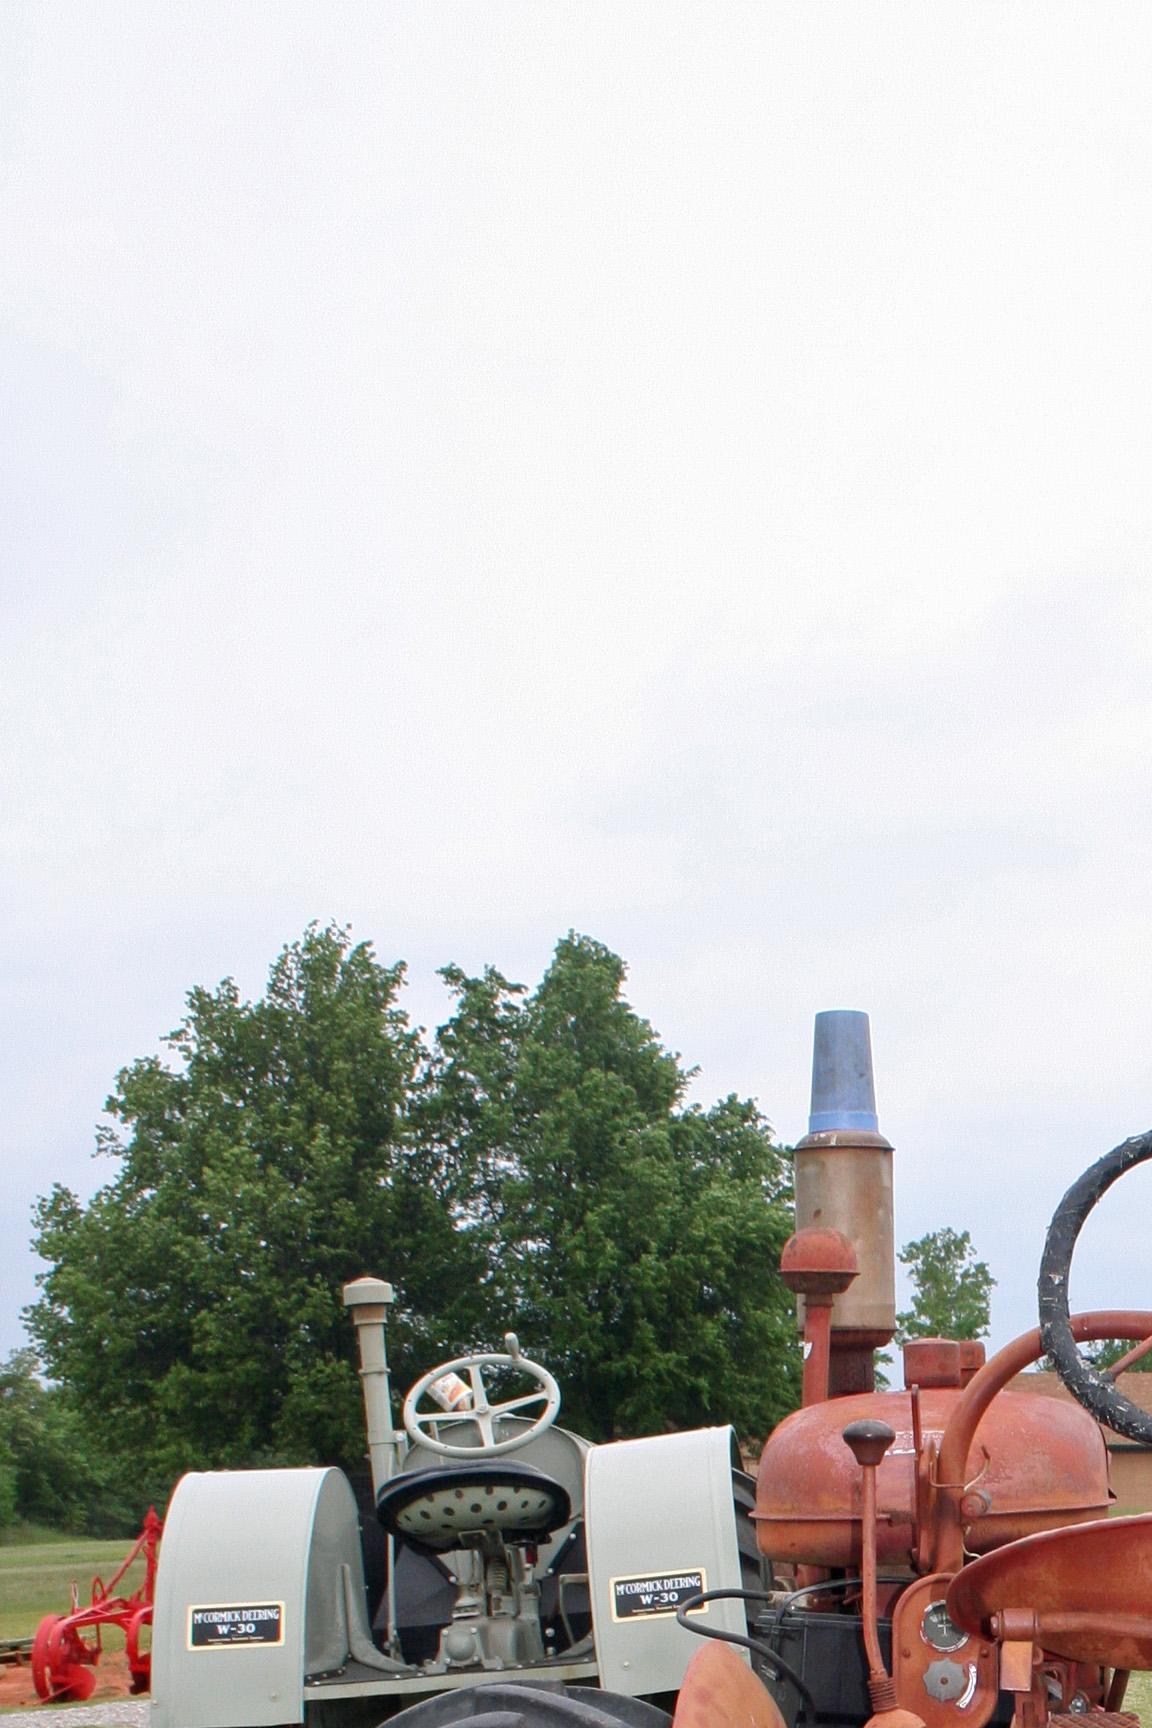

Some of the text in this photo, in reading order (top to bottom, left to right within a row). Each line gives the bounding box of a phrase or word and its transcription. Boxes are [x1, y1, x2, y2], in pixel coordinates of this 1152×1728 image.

[663, 1575, 701, 1590] DEERING
[640, 1592, 679, 1605] W-30
[241, 1608, 280, 1621] DEERING
[216, 1623, 256, 1635] W-30
